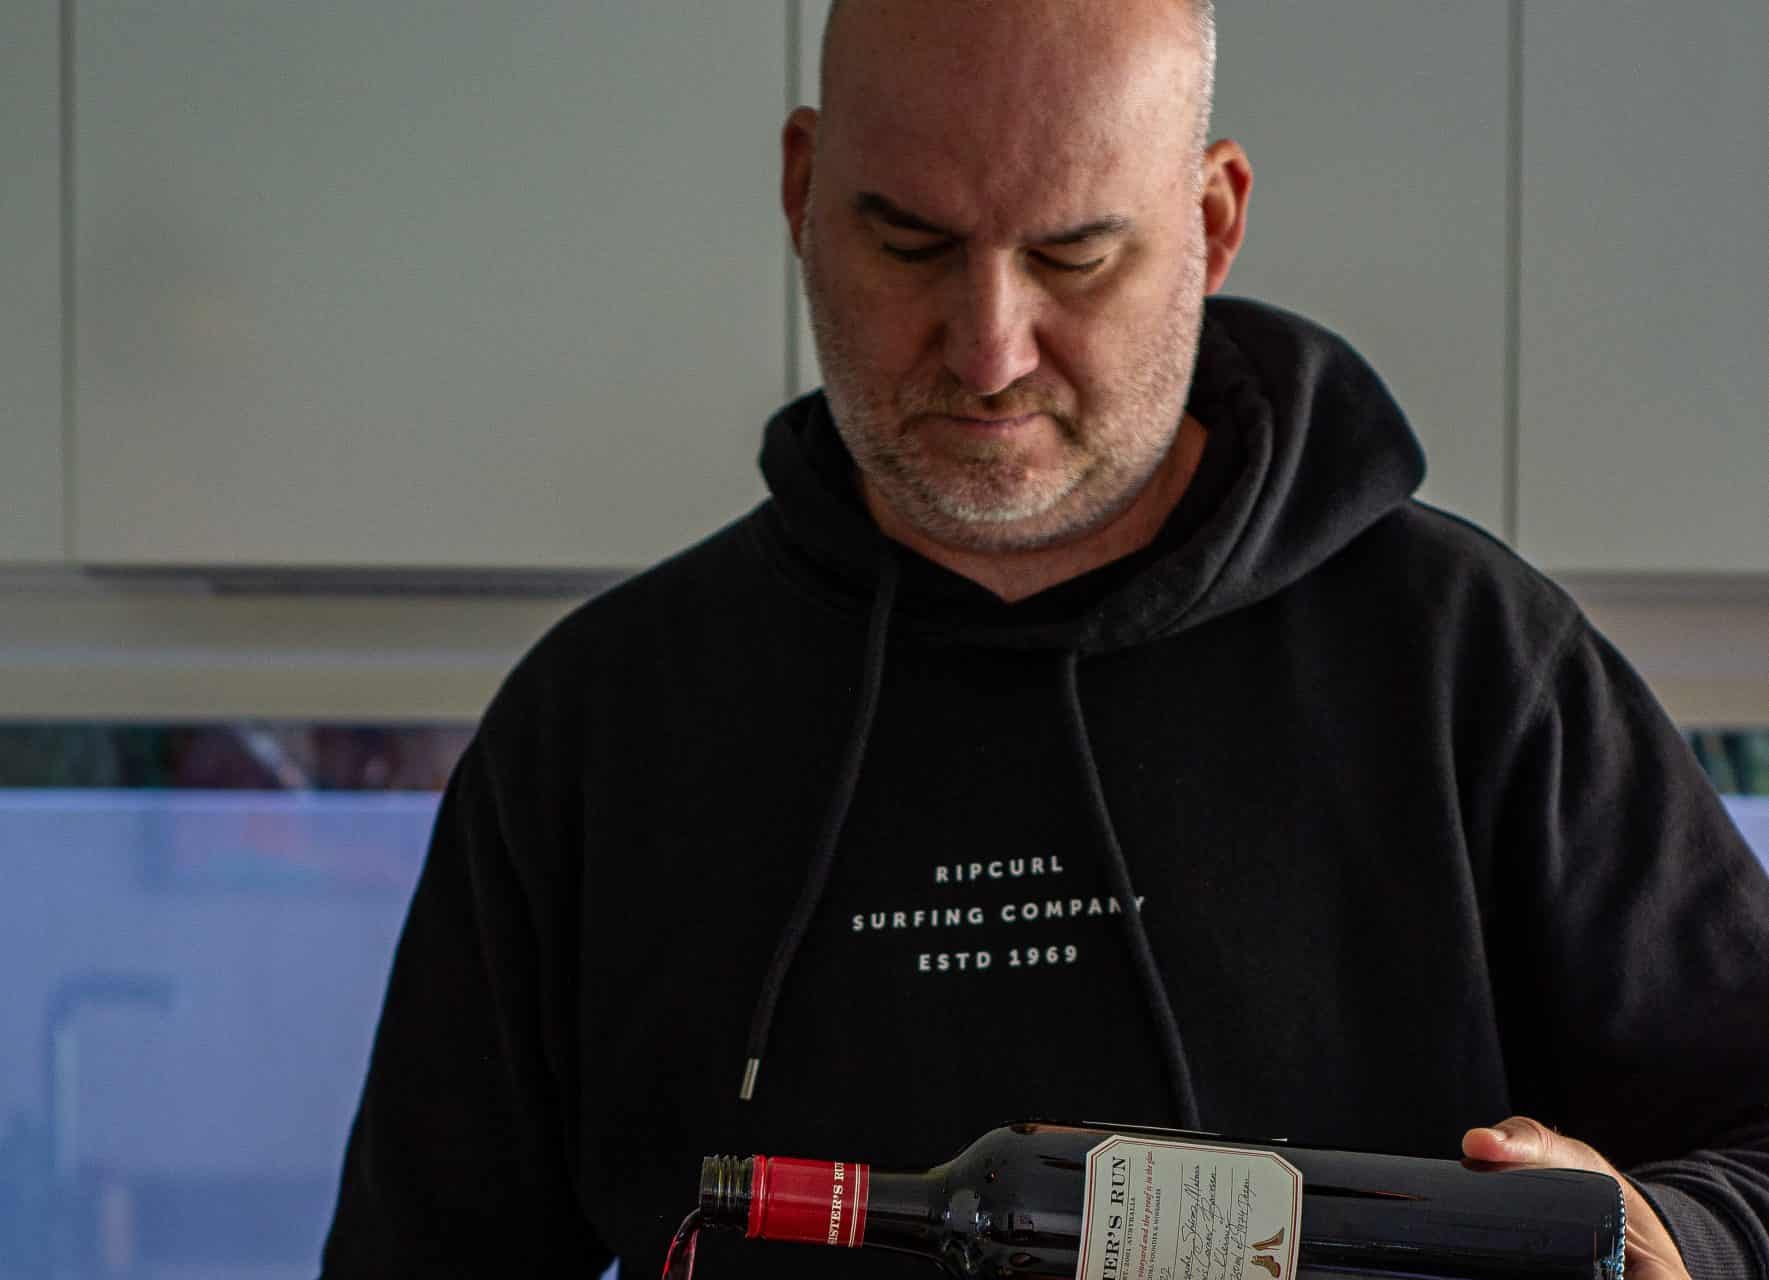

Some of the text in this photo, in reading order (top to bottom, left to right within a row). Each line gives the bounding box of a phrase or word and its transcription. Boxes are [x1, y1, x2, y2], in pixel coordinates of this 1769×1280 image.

[936, 855, 1063, 883] RIPCURL
[852, 907, 985, 931] SURFING
[918, 945, 1078, 971] ESTD 1969
[1110, 1155, 1126, 1206] RUN
[1143, 1190, 1152, 1213] proof
[1141, 1214, 1150, 1226] the
[1137, 1245, 1147, 1277] vineyard
